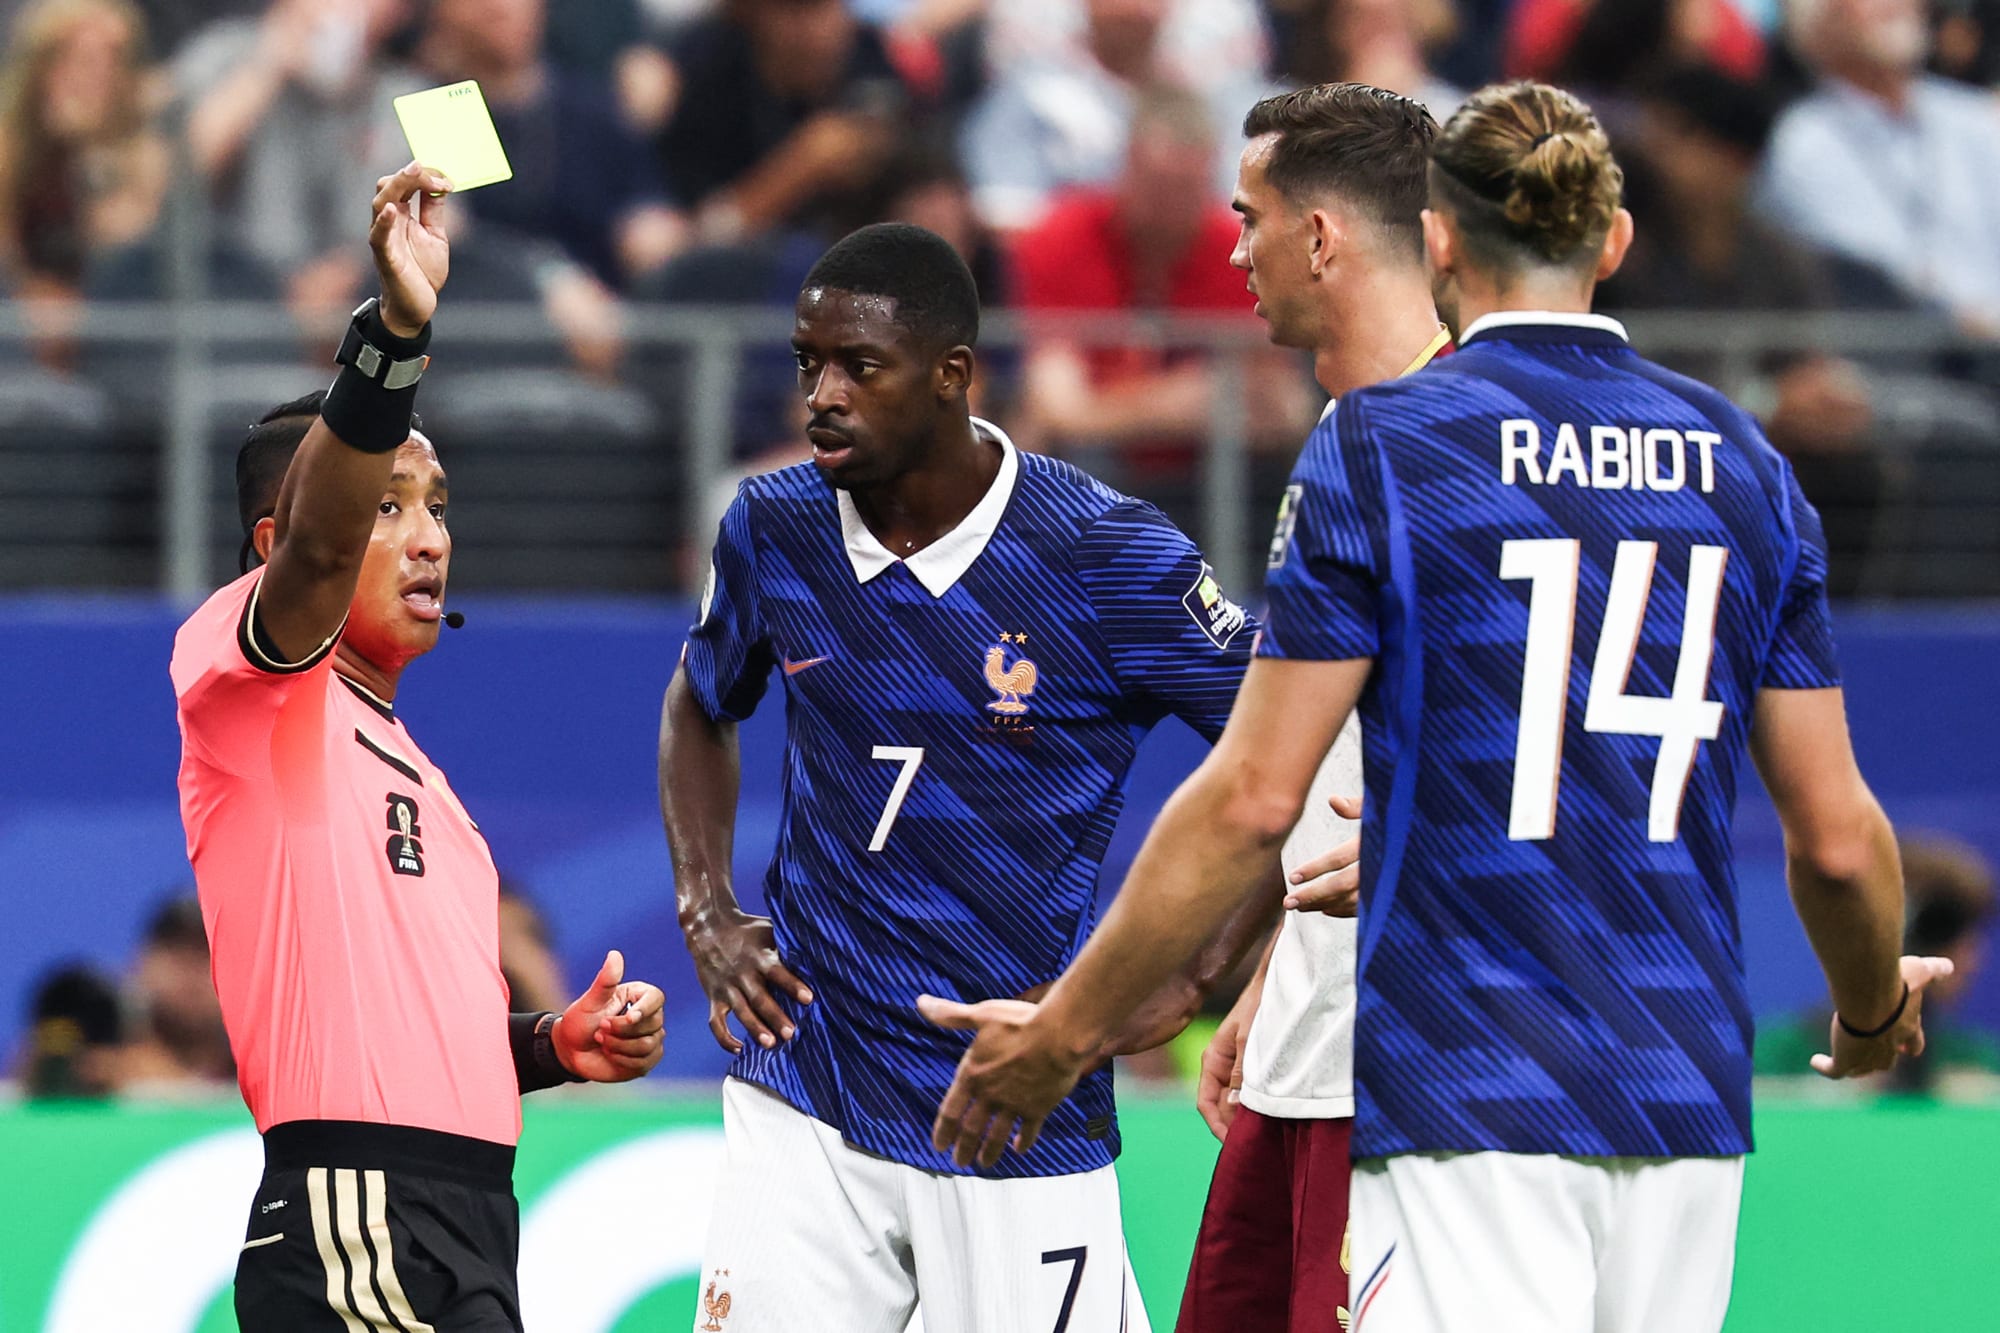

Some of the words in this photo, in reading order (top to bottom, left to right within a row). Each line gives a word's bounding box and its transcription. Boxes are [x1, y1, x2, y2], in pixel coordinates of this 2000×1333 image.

[1501, 418, 1722, 493] RABIOT
[1499, 538, 1729, 842] 14
[867, 745, 925, 852] 7
[398, 857, 420, 871] FIFA
[1041, 1245, 1088, 1333] 7
